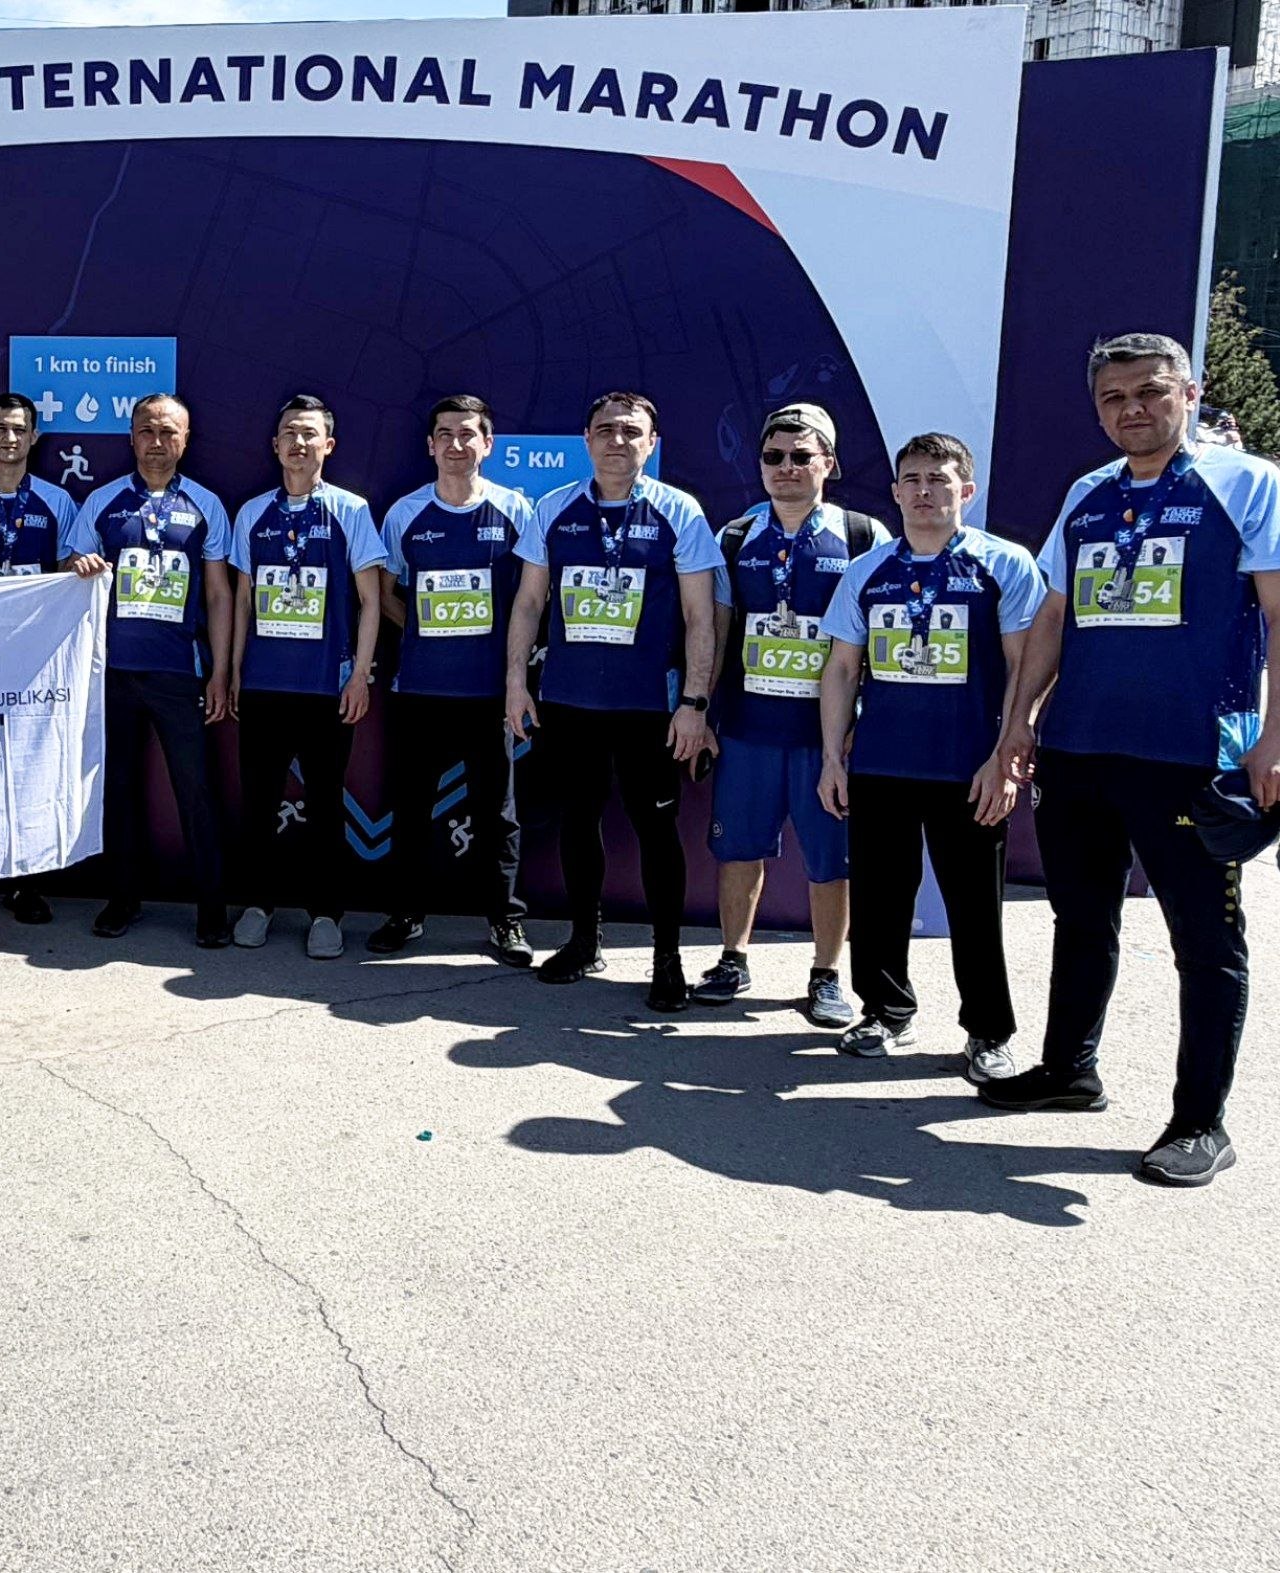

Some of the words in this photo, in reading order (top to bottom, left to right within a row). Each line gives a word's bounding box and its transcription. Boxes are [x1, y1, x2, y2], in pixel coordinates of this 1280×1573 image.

[519, 62, 949, 160] MARATHON
[34, 356, 43, 373] 1
[50, 355, 78, 373] km
[82, 357, 101, 373] to
[105, 355, 156, 374] finish
[112, 396, 138, 418] W
[504, 446, 520, 468] 5
[434, 600, 489, 621] 6736
[578, 598, 634, 620] 6751
[762, 648, 824, 672] 6739
[892, 642, 961, 665] 635
[1175, 815, 1195, 826] JA
